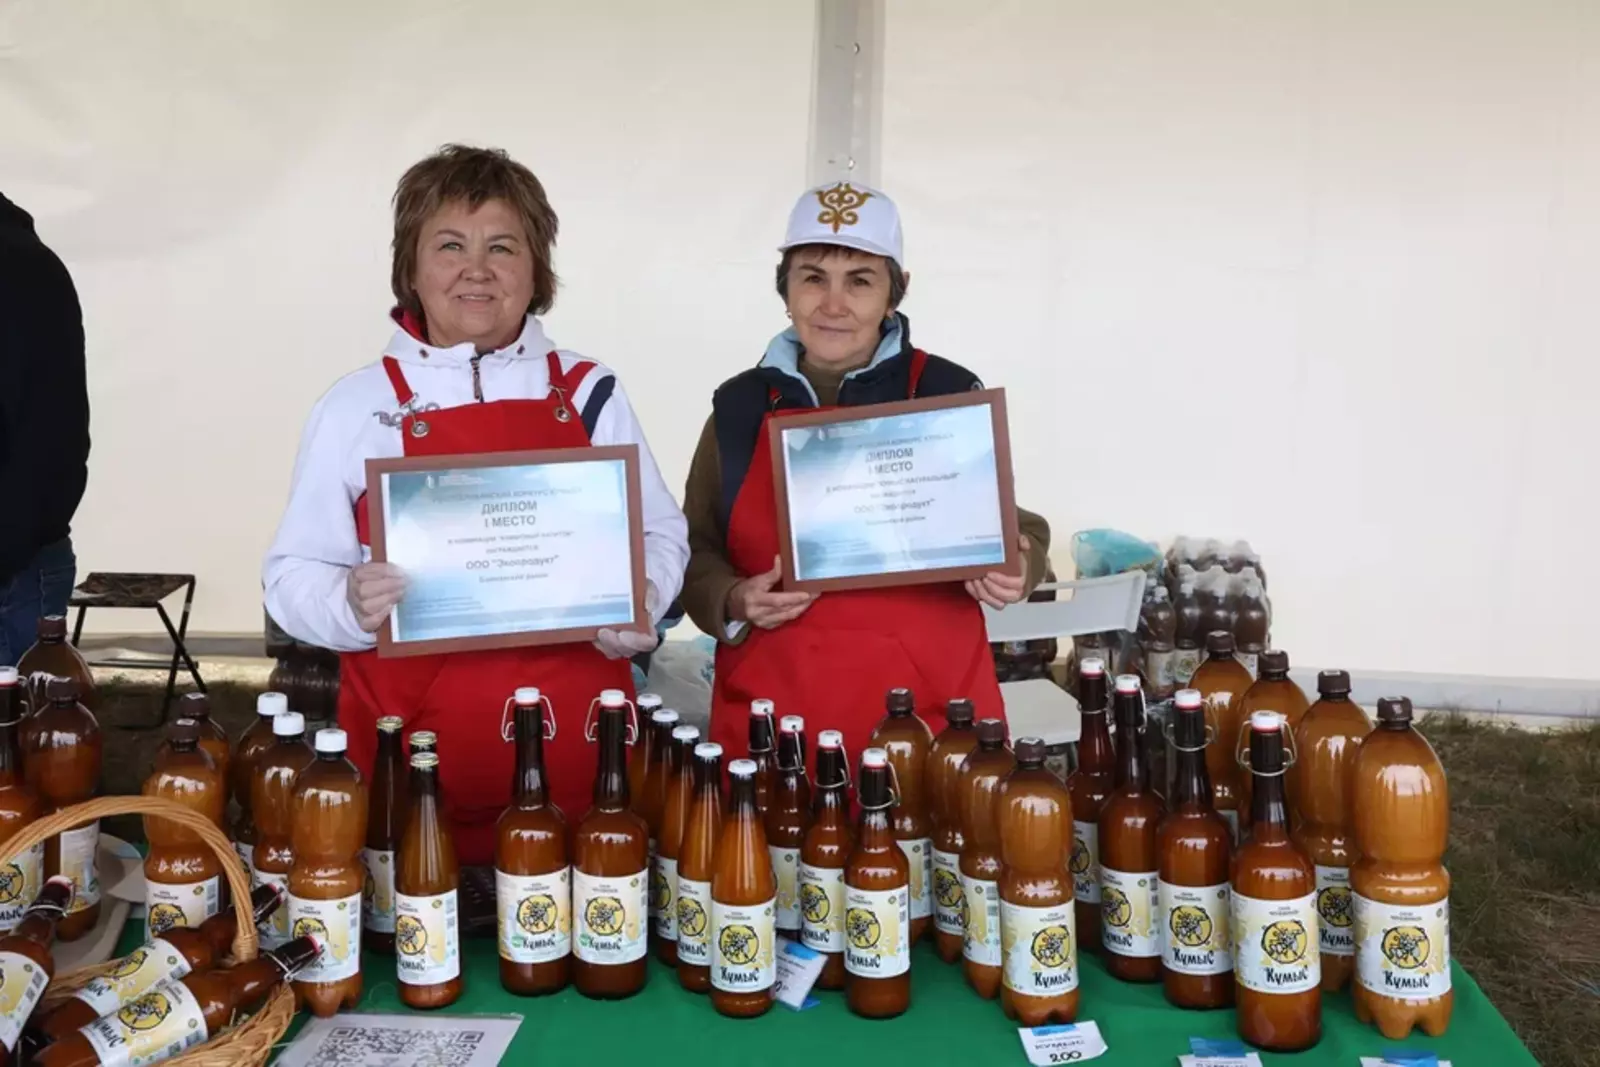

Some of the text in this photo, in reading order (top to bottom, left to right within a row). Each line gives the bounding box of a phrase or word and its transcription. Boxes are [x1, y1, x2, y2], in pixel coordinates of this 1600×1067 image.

[865, 447, 914, 463] ДИПЛОМ
[874, 460, 914, 473] МЕСТО
[481, 500, 538, 515] ДИПЛОМ
[492, 514, 536, 528] МЕСТО
[466, 559, 490, 570] ООО
[1173, 946, 1215, 967] Кумыс
[720, 966, 760, 985] Кумыс
[1033, 965, 1073, 989] Кумыс
[1265, 964, 1309, 987] Кумыс
[1383, 969, 1431, 989] Кумыс
[1049, 1049, 1083, 1063] 200
